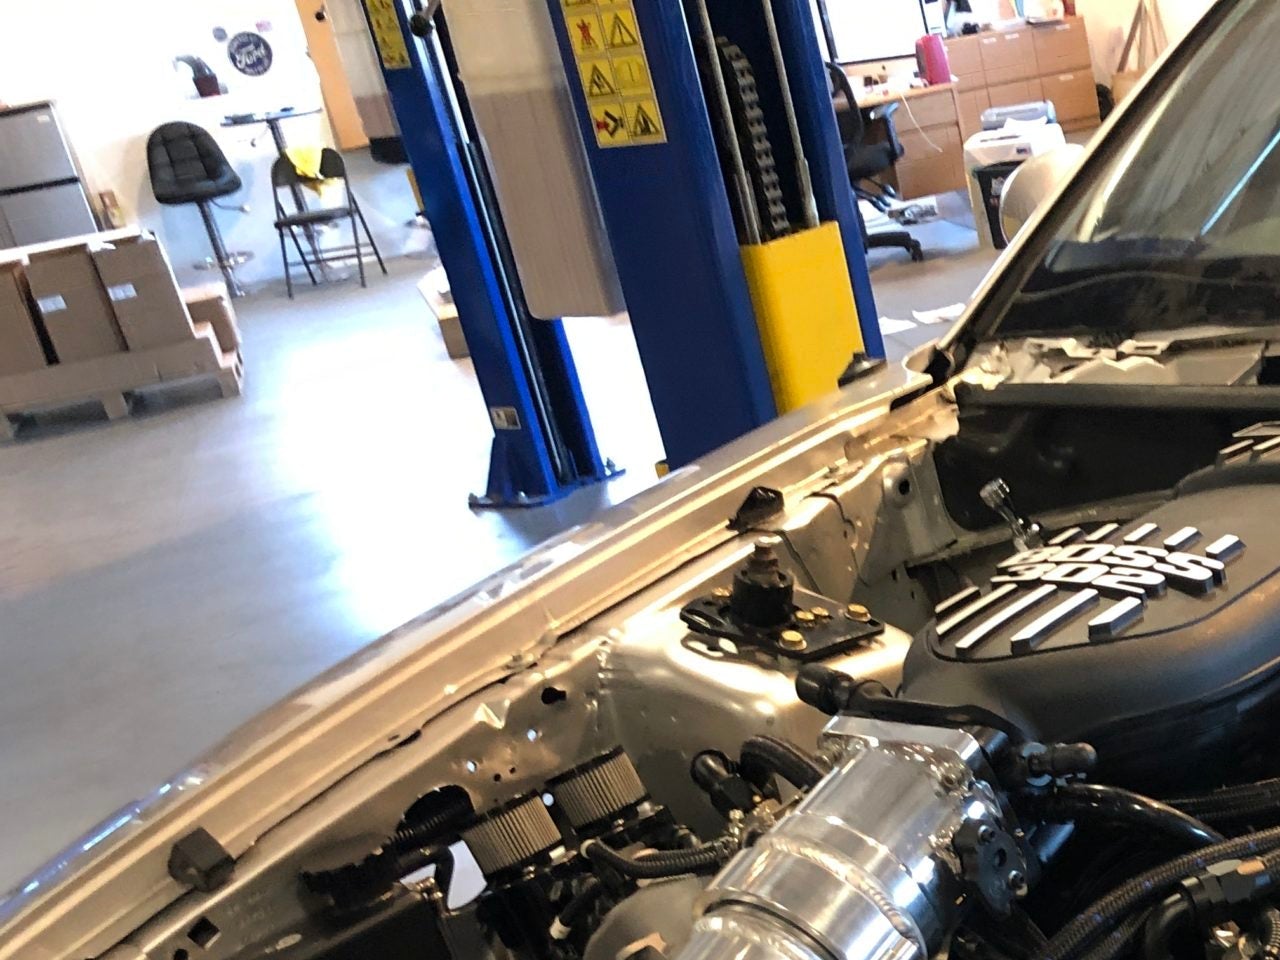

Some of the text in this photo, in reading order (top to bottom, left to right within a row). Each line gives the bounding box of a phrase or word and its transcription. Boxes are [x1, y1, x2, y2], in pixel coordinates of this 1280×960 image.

[236, 42, 266, 69] Ford
[990, 562, 1166, 596] 302
[997, 543, 1225, 586] BOSS
